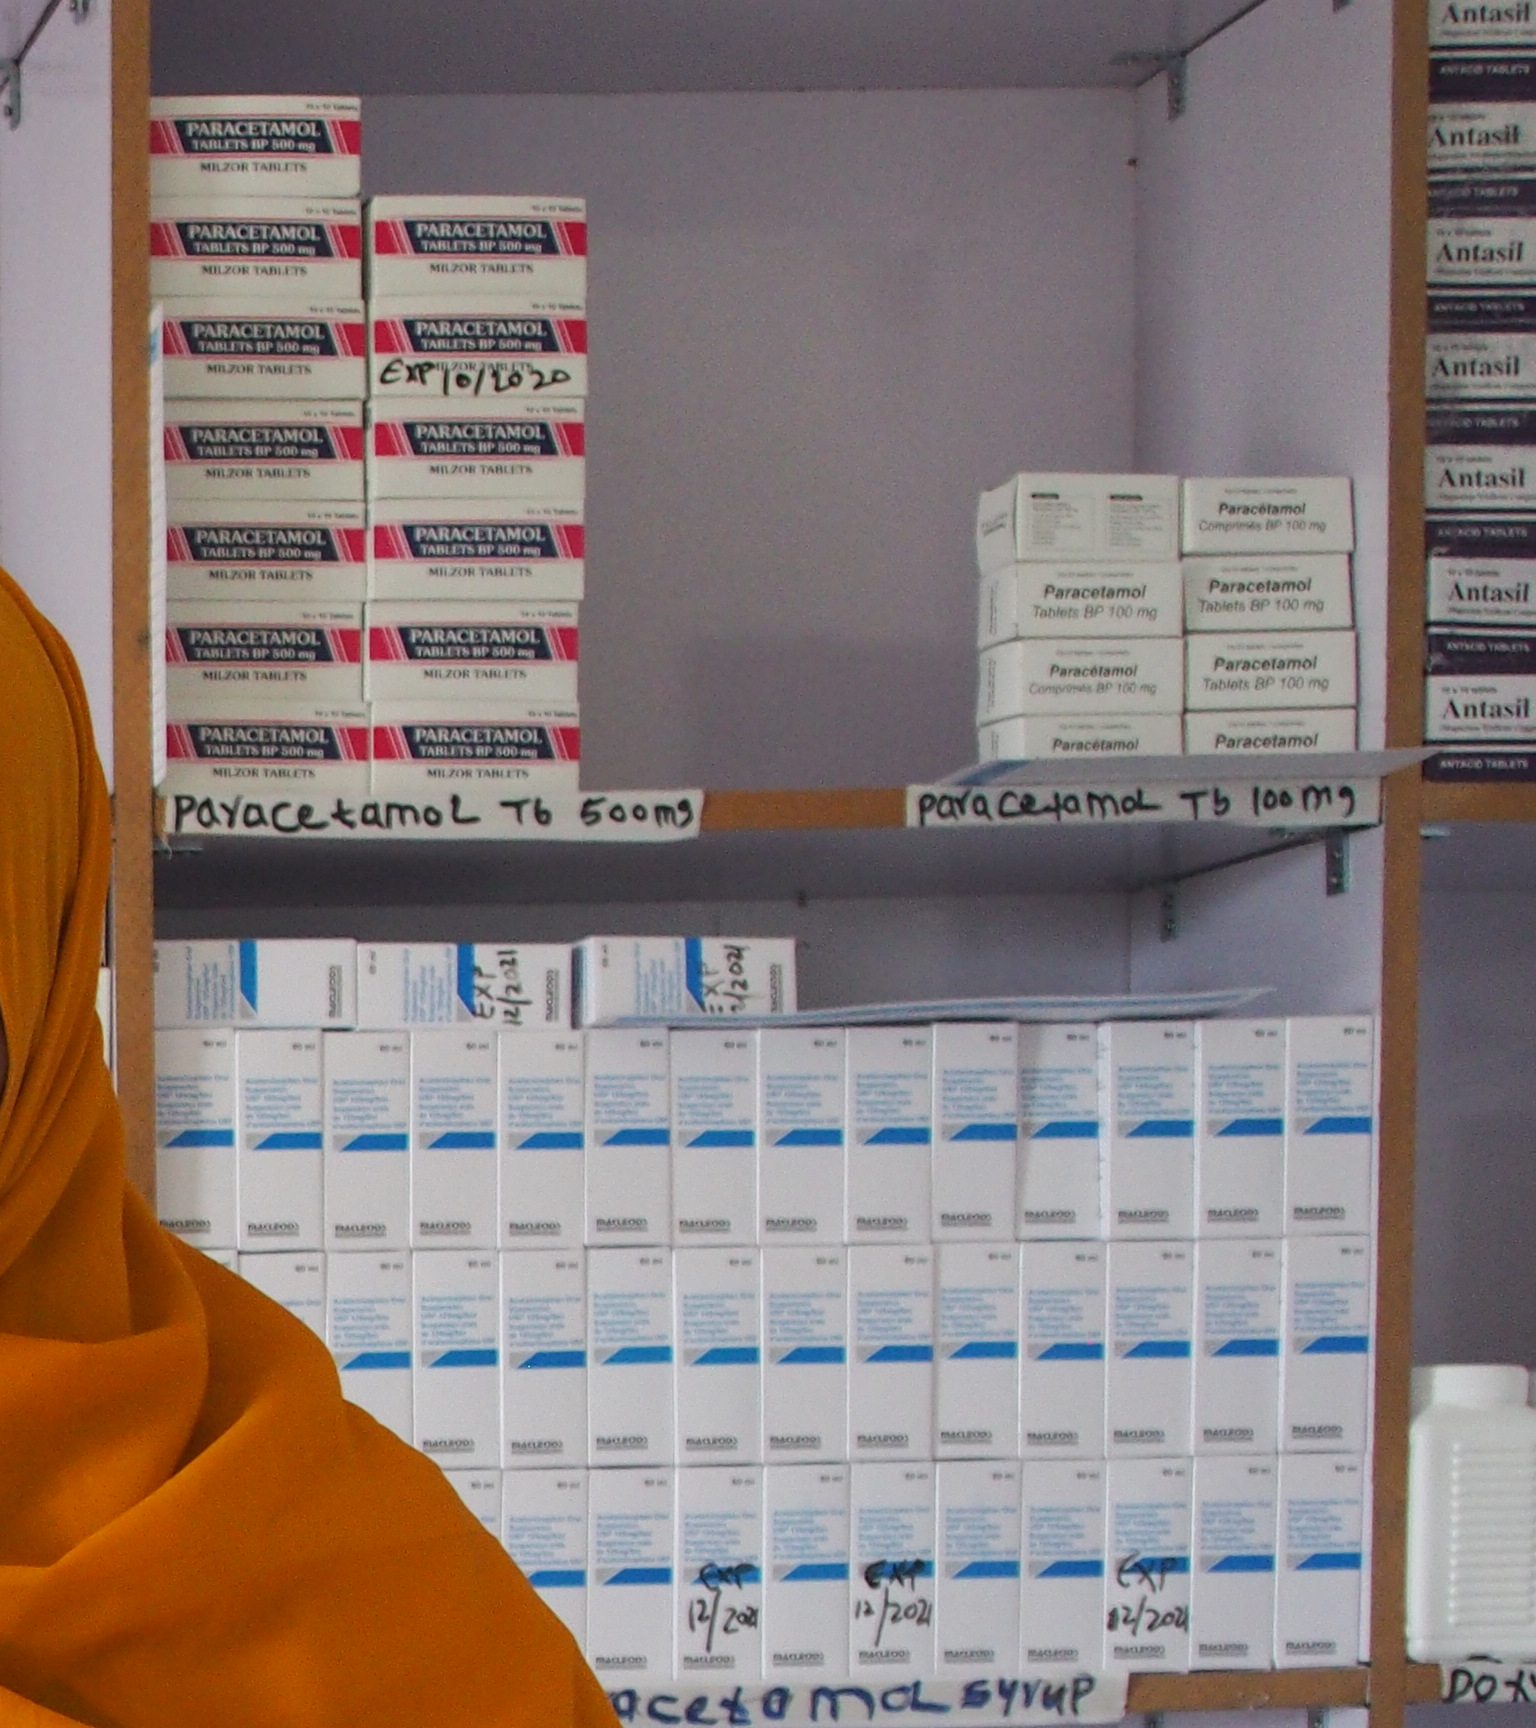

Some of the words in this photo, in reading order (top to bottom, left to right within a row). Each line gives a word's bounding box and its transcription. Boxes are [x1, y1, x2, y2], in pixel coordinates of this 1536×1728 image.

[186, 121, 321, 137] PARACETAMOL
[1429, 126, 1520, 146] Antasil
[192, 139, 248, 151] TABLETS
[251, 139, 269, 151] BP
[272, 139, 295, 152] 500
[298, 140, 316, 153] mg
[201, 162, 248, 173] MILZOR
[252, 162, 306, 173] TABLETS
[415, 223, 546, 239] PARACETAMOL
[415, 424, 545, 440] PARACETAMOL
[1438, 468, 1525, 489] Antasil
[196, 530, 326, 545] PARACETAMOL
[1044, 584, 1146, 600] Paracetamol
[1208, 578, 1311, 595] Paracetamol
[1033, 606, 1078, 620] Tablets
[1083, 606, 1103, 620] BP
[1108, 606, 1131, 620] 100
[1135, 607, 1157, 622] mg
[411, 628, 540, 645] PARACETAMOL
[1443, 699, 1528, 719] Antasil
[1215, 733, 1318, 750] Paracetamol
